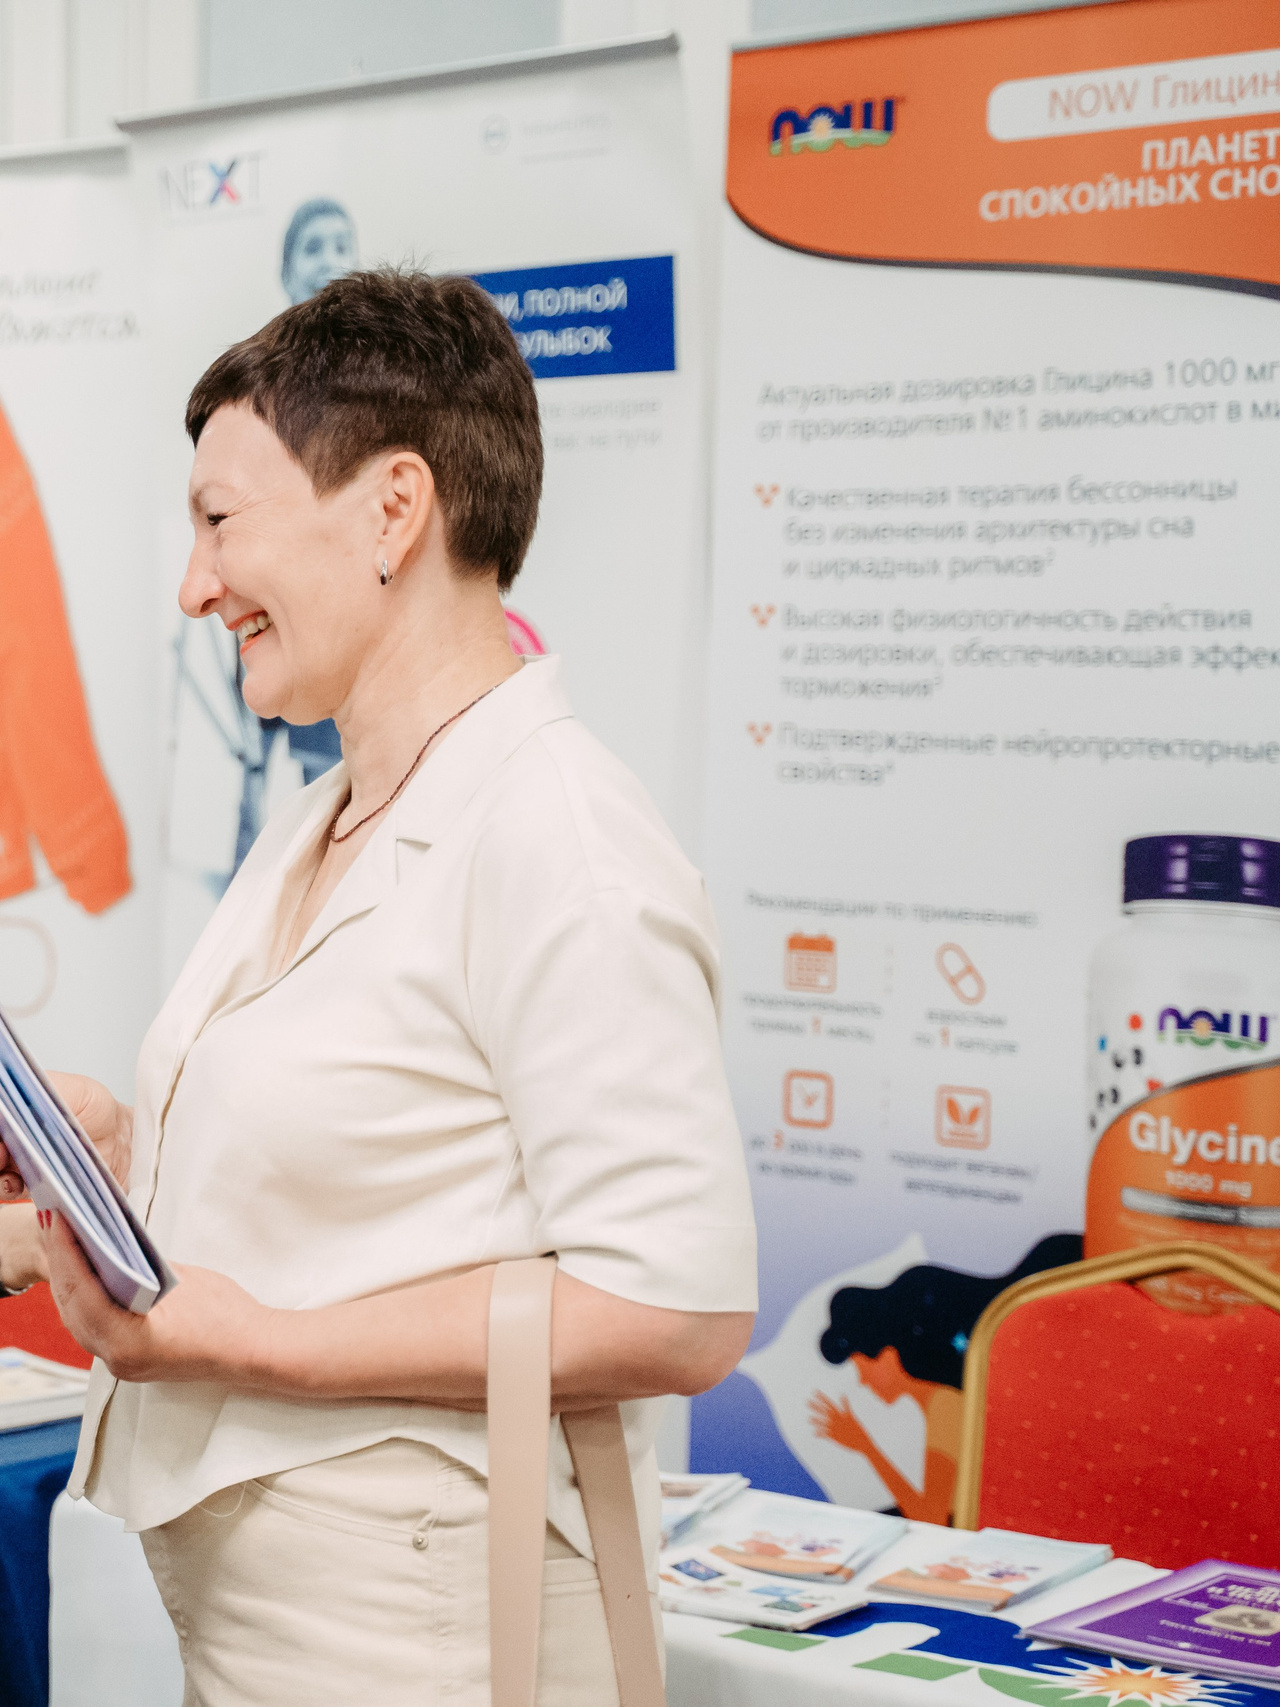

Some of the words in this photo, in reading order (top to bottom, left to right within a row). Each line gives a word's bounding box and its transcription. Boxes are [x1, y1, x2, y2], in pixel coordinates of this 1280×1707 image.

[1049, 79, 1139, 120] NOW
[1141, 127, 1280, 172] ПЛАНЕТ
[979, 171, 1200, 222] СПОКОЙНЫХ
[1209, 163, 1280, 201] СНО
[523, 277, 628, 317] ПОЛНОЙ
[900, 376, 1035, 404] дозировка
[1163, 356, 1238, 389] 1000
[1038, 401, 1218, 431] аминокислот
[785, 484, 951, 509] Качественная
[957, 482, 1061, 510] терапия
[1067, 474, 1238, 504] бессонницы
[784, 517, 825, 545] без
[831, 521, 967, 544] изменения
[974, 517, 1140, 547] архитектуры
[1147, 515, 1196, 540] сна
[782, 603, 882, 630] Высокая
[1123, 601, 1253, 633] действия
[951, 635, 1182, 671] обеспечивающая
